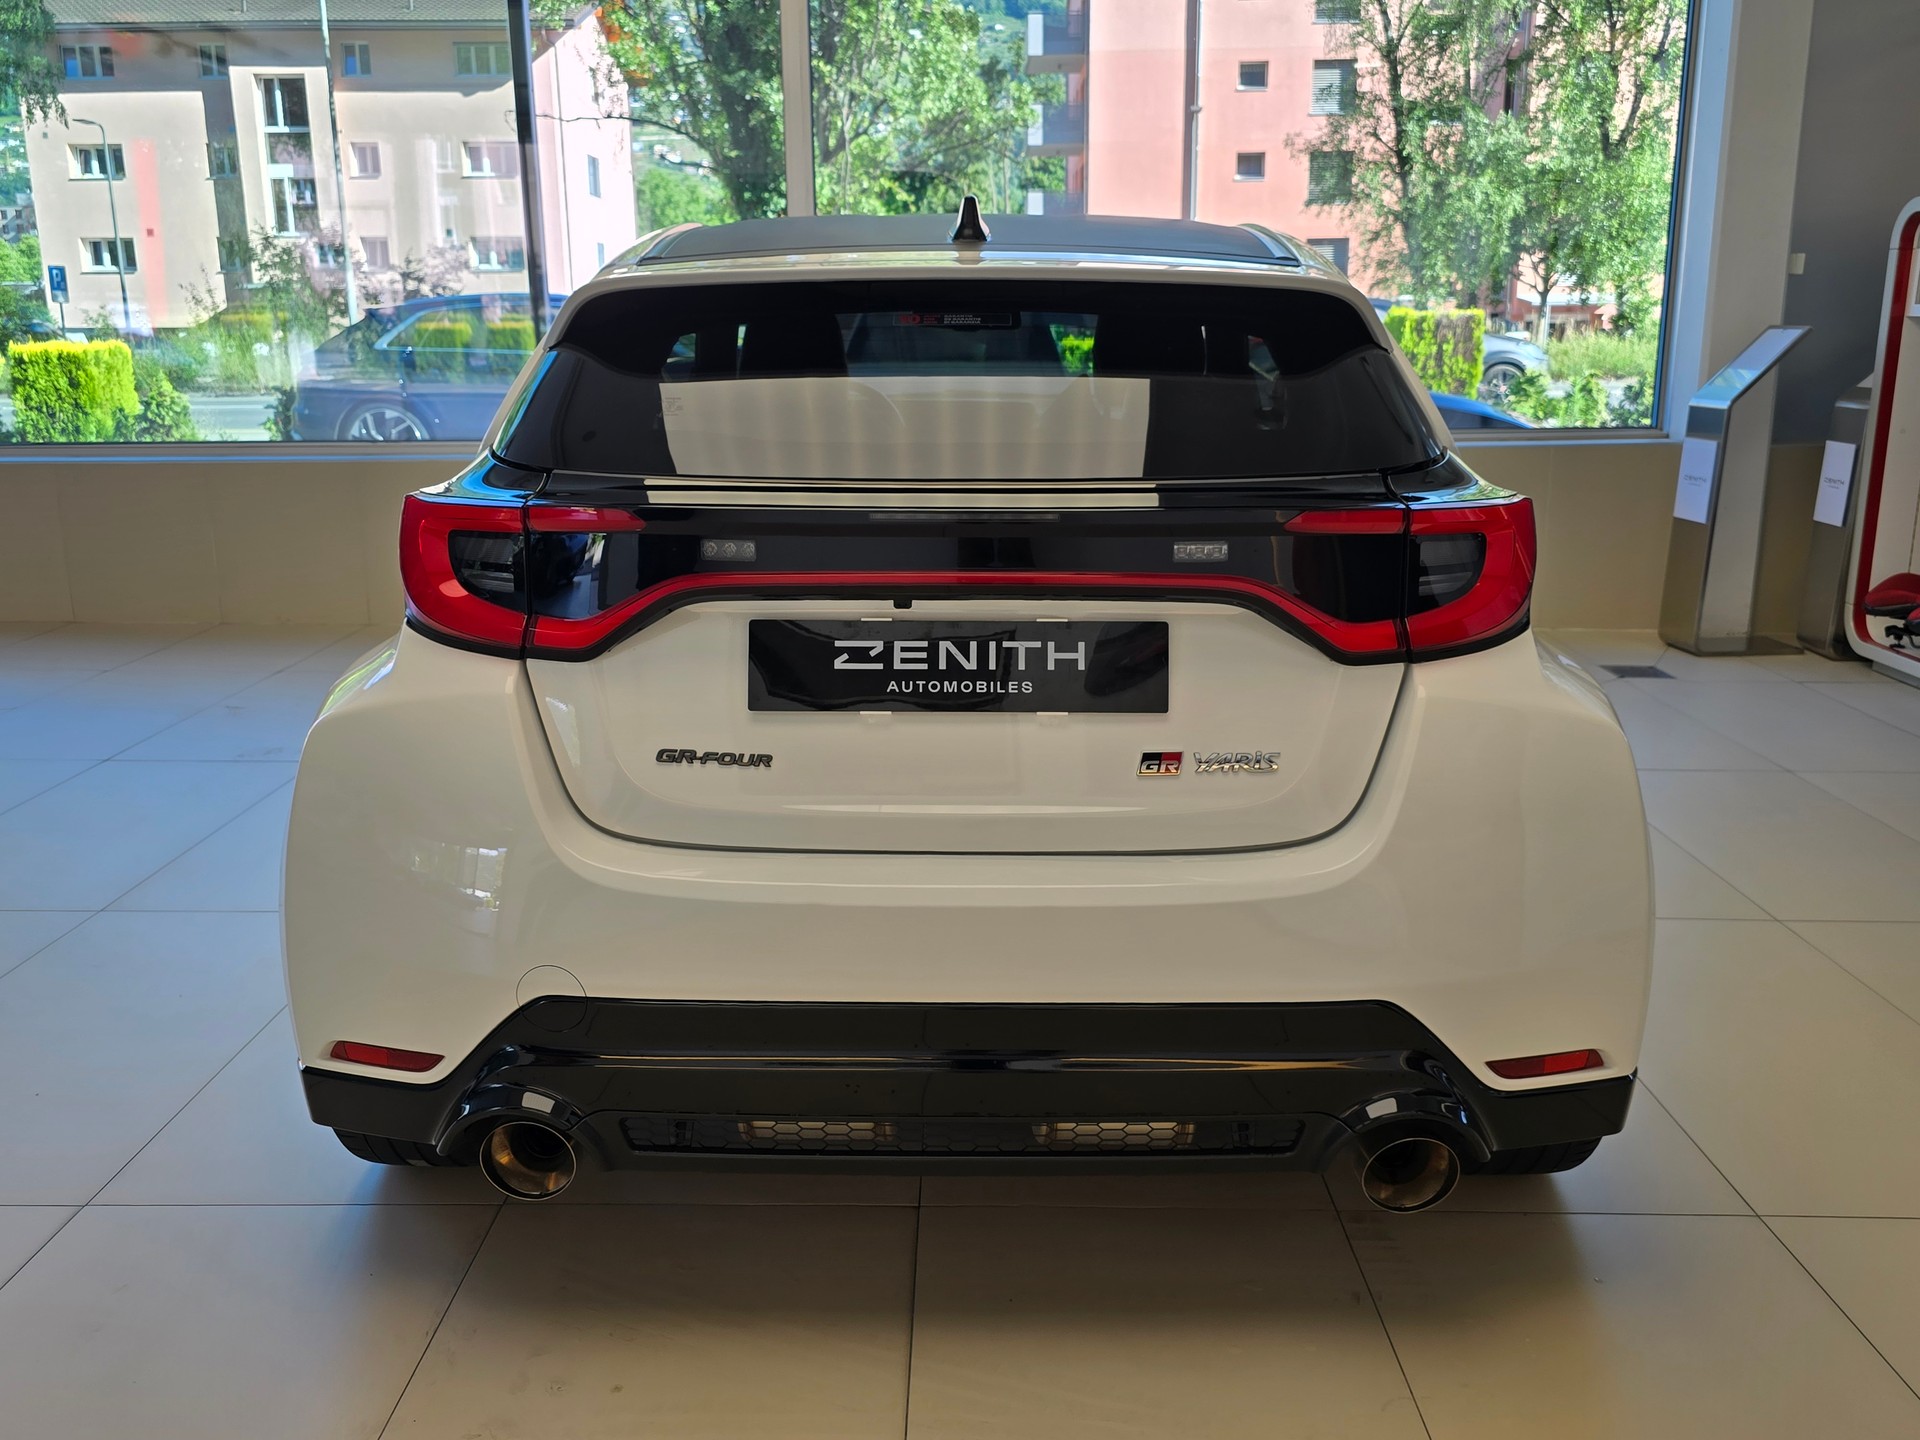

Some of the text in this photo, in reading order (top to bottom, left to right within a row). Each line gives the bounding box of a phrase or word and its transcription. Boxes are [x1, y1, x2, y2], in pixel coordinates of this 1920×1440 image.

[52, 268, 61, 287] P
[833, 640, 1085, 671] ZENITH
[886, 680, 1033, 694] AUTOMOBILES
[656, 748, 773, 768] GR-FOUR
[1140, 760, 1179, 774] GR
